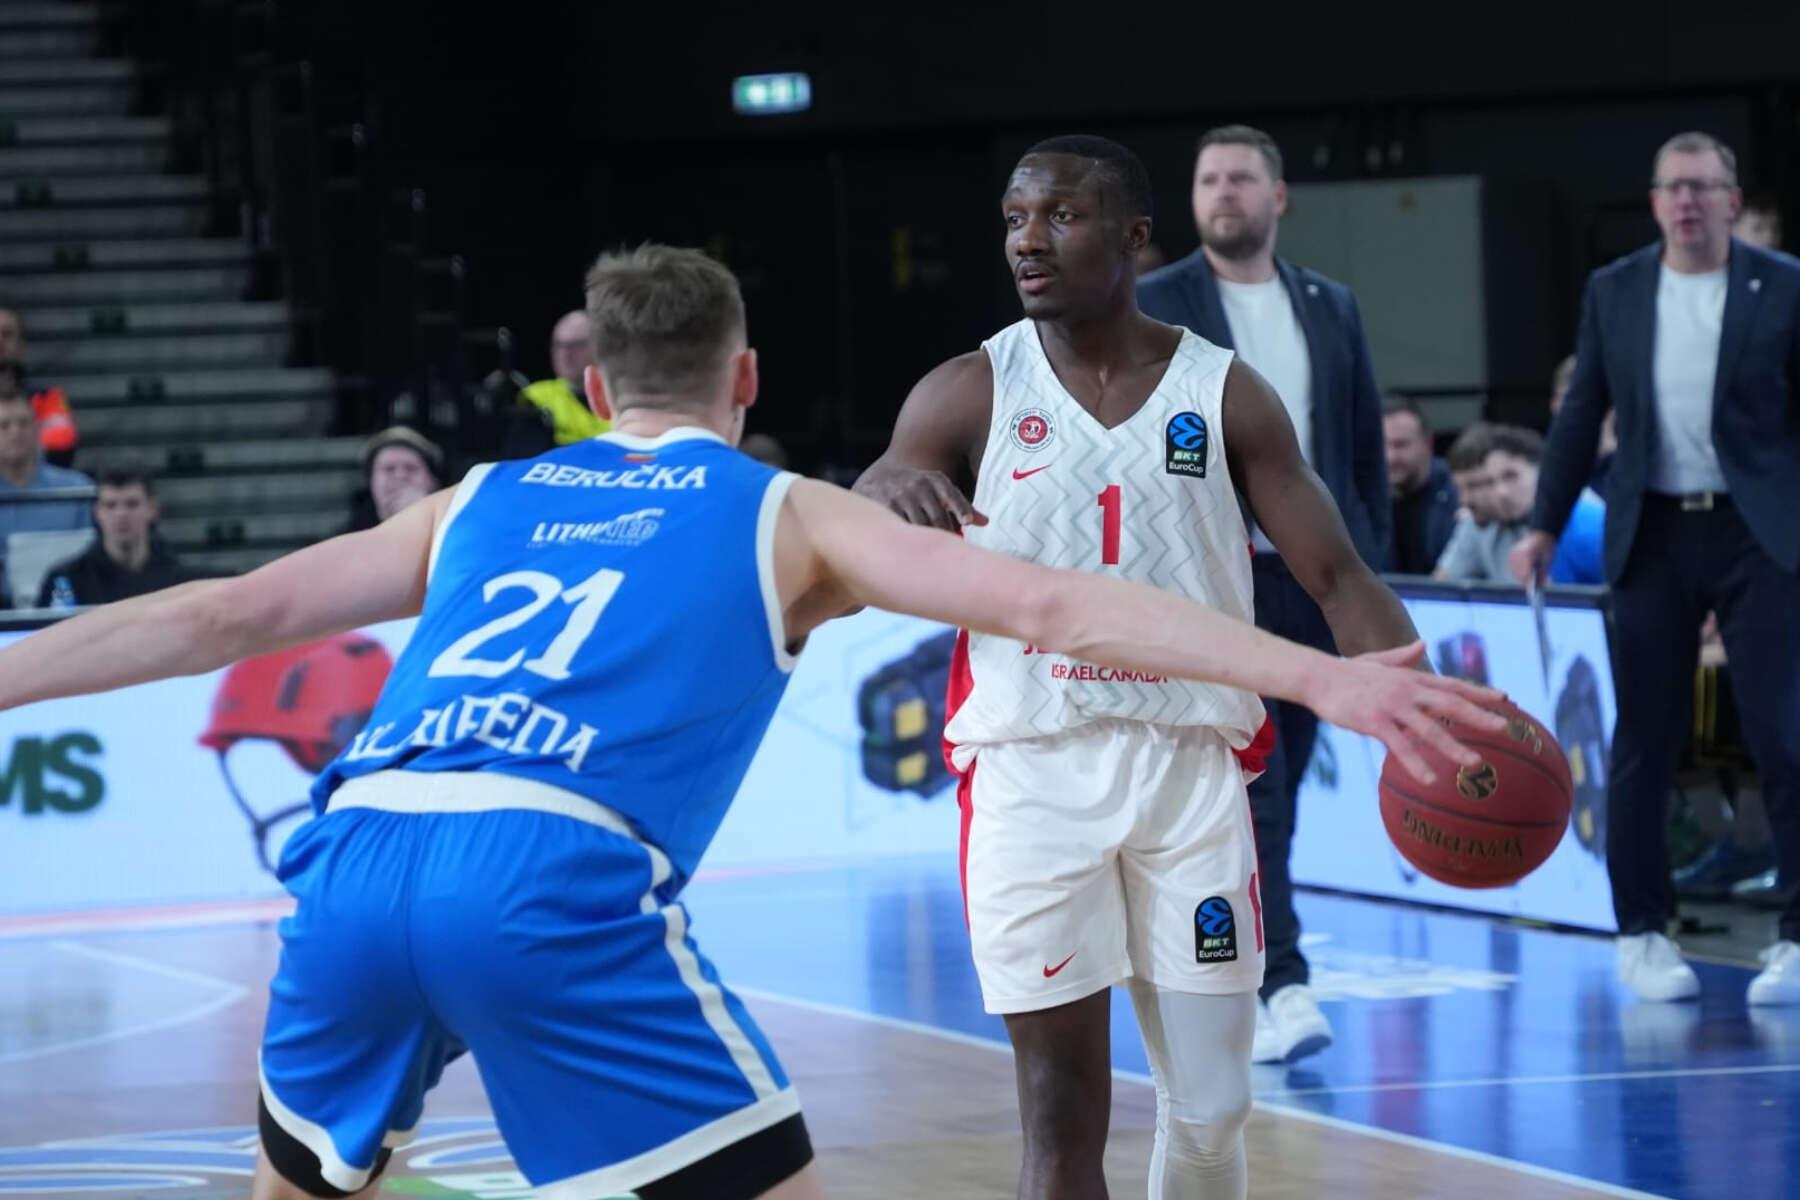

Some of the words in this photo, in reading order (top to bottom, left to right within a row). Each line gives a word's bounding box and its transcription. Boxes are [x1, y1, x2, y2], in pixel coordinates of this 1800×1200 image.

[1174, 450, 1200, 461] BKT
[1168, 461, 1204, 474] EuroCup
[519, 462, 708, 490] BERUČKA
[1097, 485, 1121, 566] 1
[427, 567, 625, 680] 21
[1203, 937, 1230, 948] BKT
[1199, 948, 1235, 959] EuroCup
